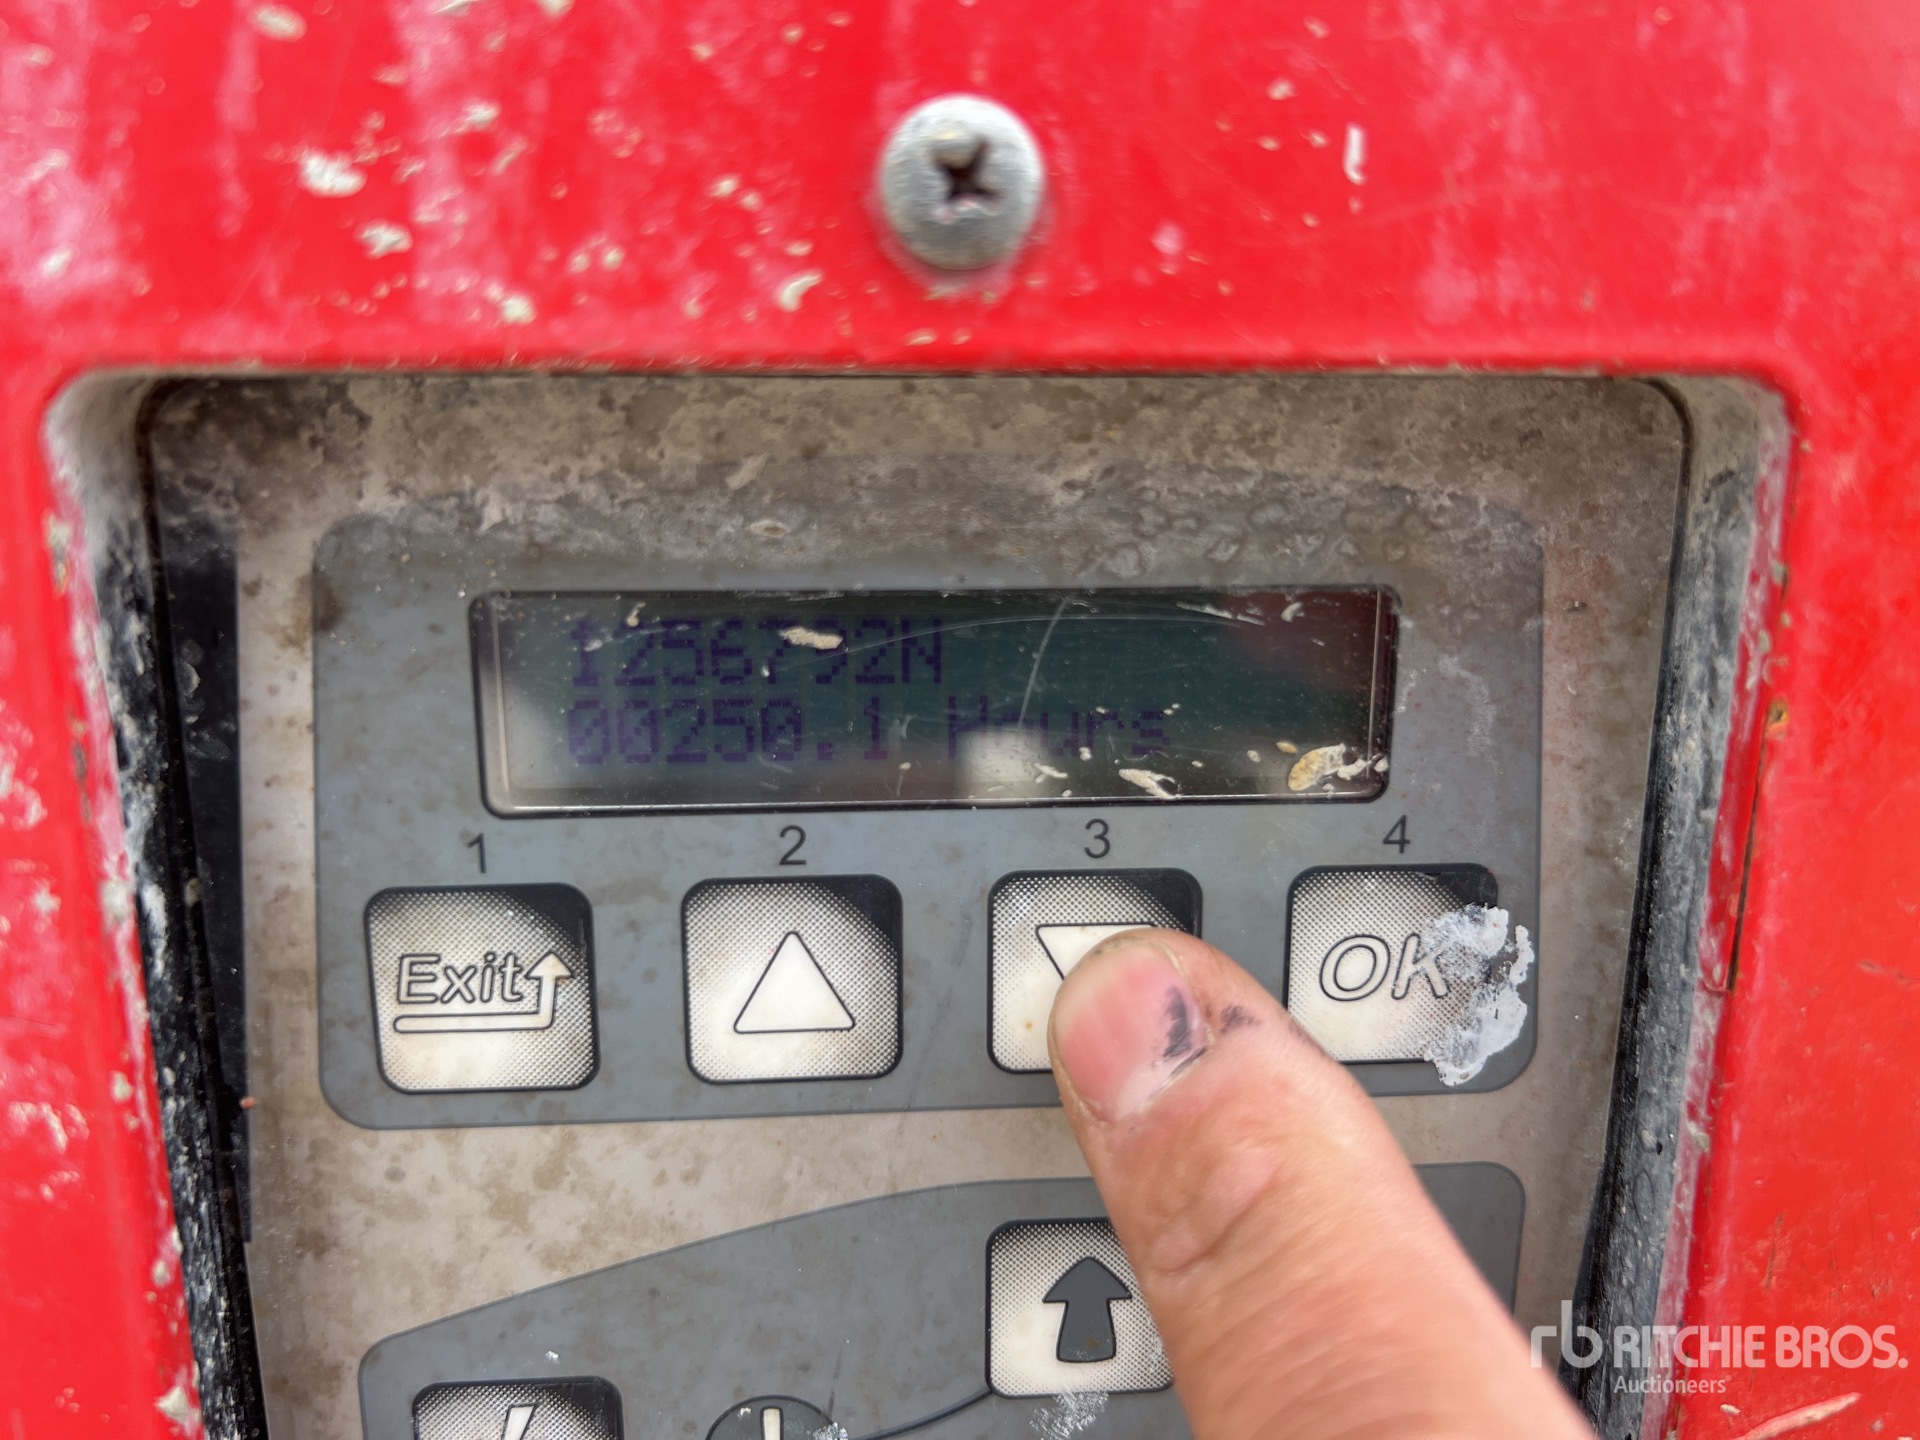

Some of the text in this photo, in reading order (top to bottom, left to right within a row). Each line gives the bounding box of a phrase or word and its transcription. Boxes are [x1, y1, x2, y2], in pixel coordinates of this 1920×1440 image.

[571, 619, 941, 687] 1256792N
[567, 697, 888, 763] 00250.1
[467, 833, 487, 874] 1
[779, 825, 807, 866] 2
[1084, 818, 1111, 859] 3
[1382, 814, 1411, 854] 4
[397, 950, 524, 1005] Exit
[1318, 932, 1450, 1002] OK
